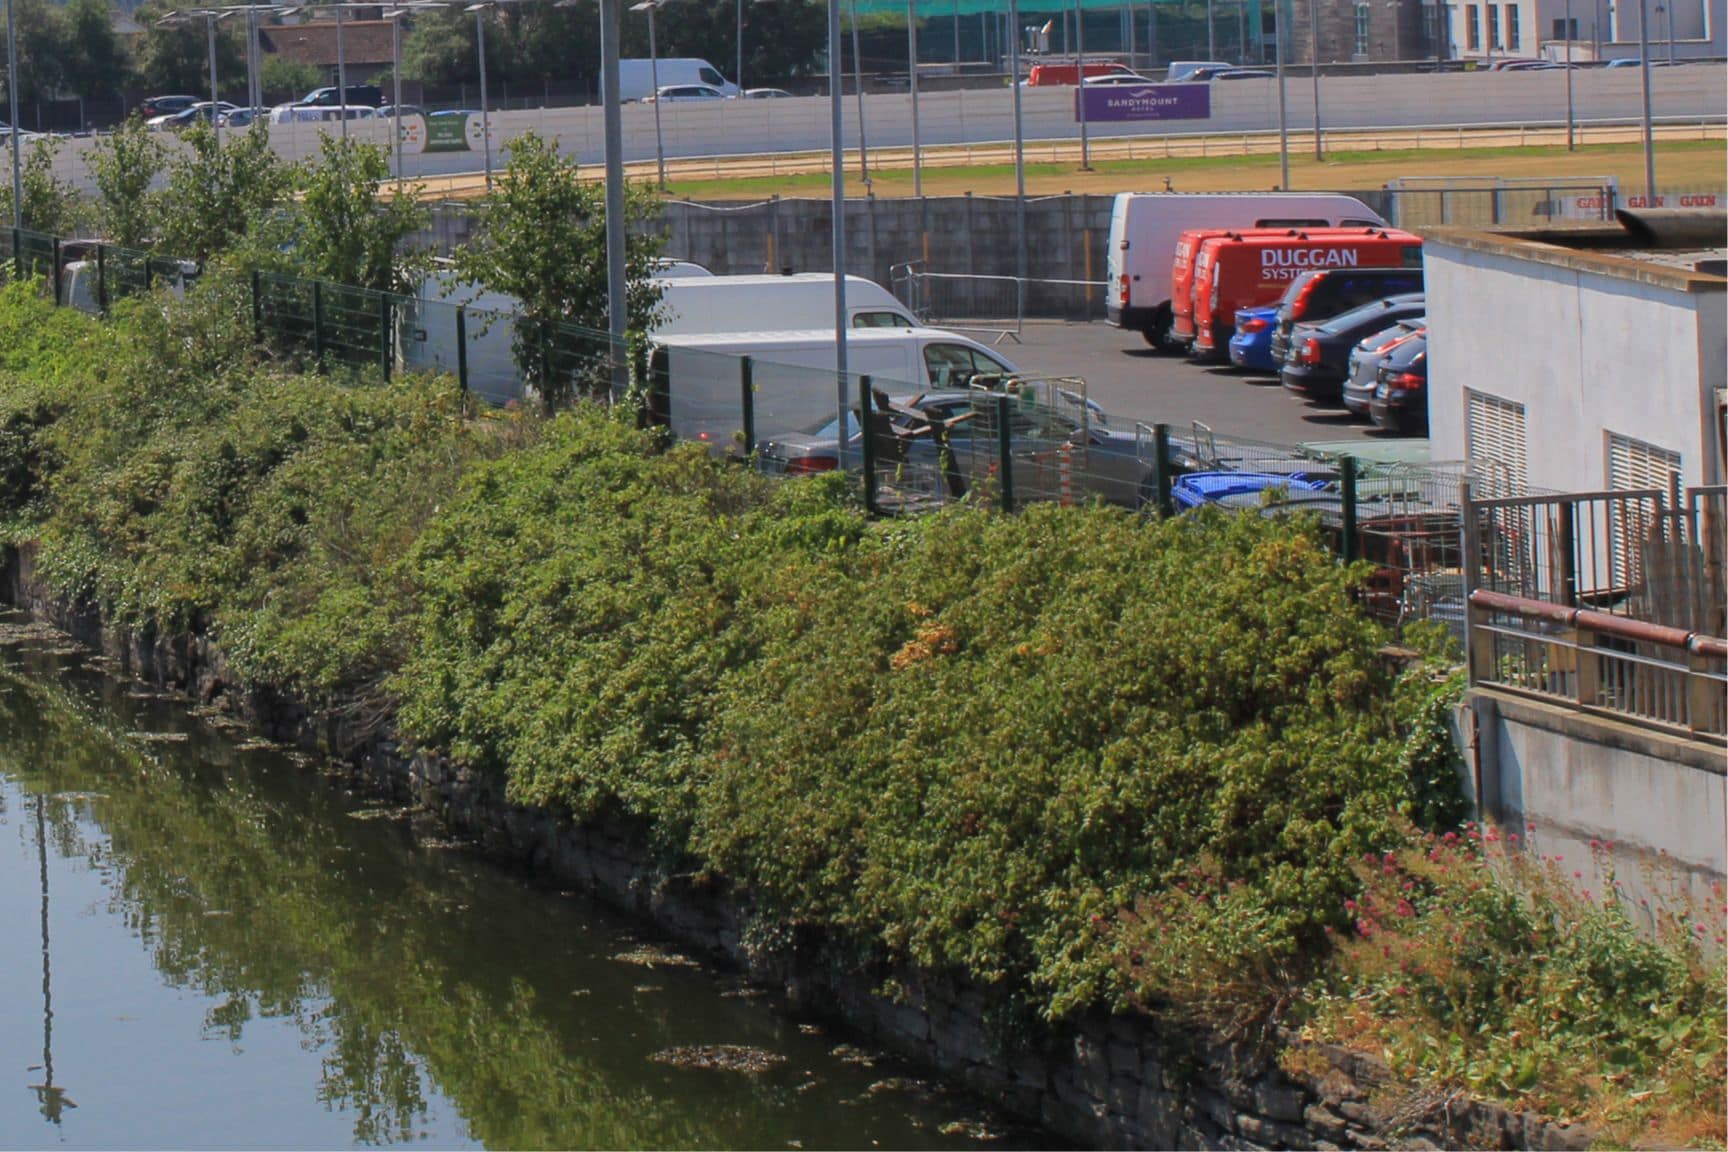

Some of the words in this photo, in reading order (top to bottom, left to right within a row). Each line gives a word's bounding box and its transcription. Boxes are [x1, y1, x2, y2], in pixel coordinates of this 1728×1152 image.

[1107, 97, 1178, 107] SANDYMOUNT
[1628, 196, 1665, 208] GAN
[1680, 195, 1716, 207] GAIN
[1261, 249, 1357, 266] DUGGAN
